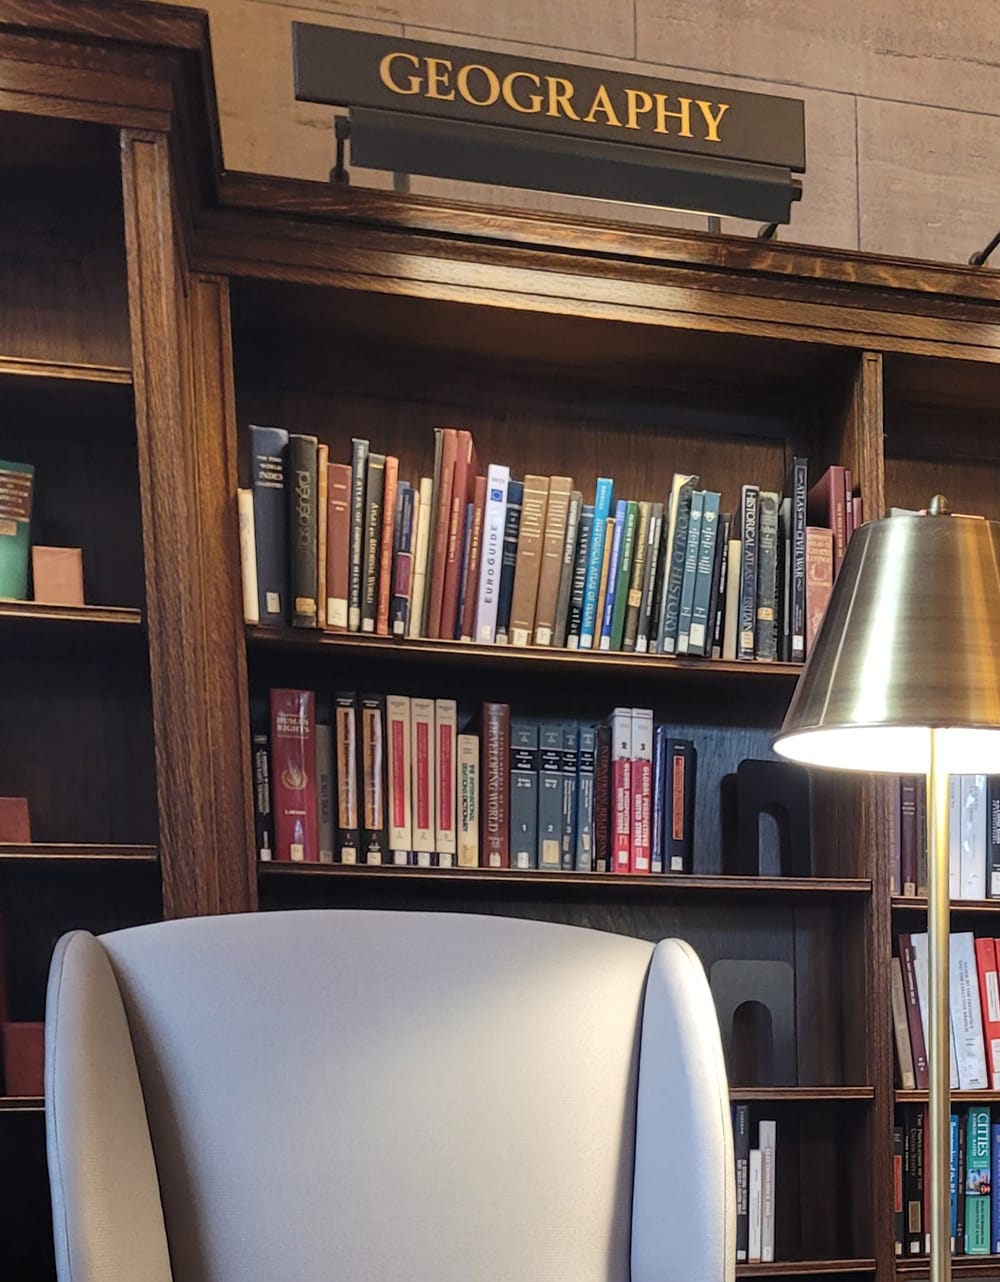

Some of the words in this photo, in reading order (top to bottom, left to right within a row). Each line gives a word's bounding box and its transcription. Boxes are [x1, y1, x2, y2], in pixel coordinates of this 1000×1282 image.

[378, 51, 731, 144] GEOGRAPHY
[796, 484, 806, 512] ATLAS
[672, 499, 690, 563] WORLD
[744, 491, 757, 549] HISTORICAL
[591, 518, 603, 565] HISTORICAL
[795, 530, 805, 555] CIVIL
[483, 524, 500, 604] EUROGUIDE
[588, 566, 599, 590] ATLAS
[743, 550, 755, 580] ATLAS
[795, 557, 805, 579] WAR
[573, 567, 586, 603] BIBLE
[664, 565, 683, 634] HISTORY
[569, 607, 581, 634] atlas
[741, 595, 754, 633] BRITAIN
[488, 720, 500, 791] DEVELOPING
[488, 792, 499, 833] WORLD
[977, 1112, 989, 1157] CITIES
